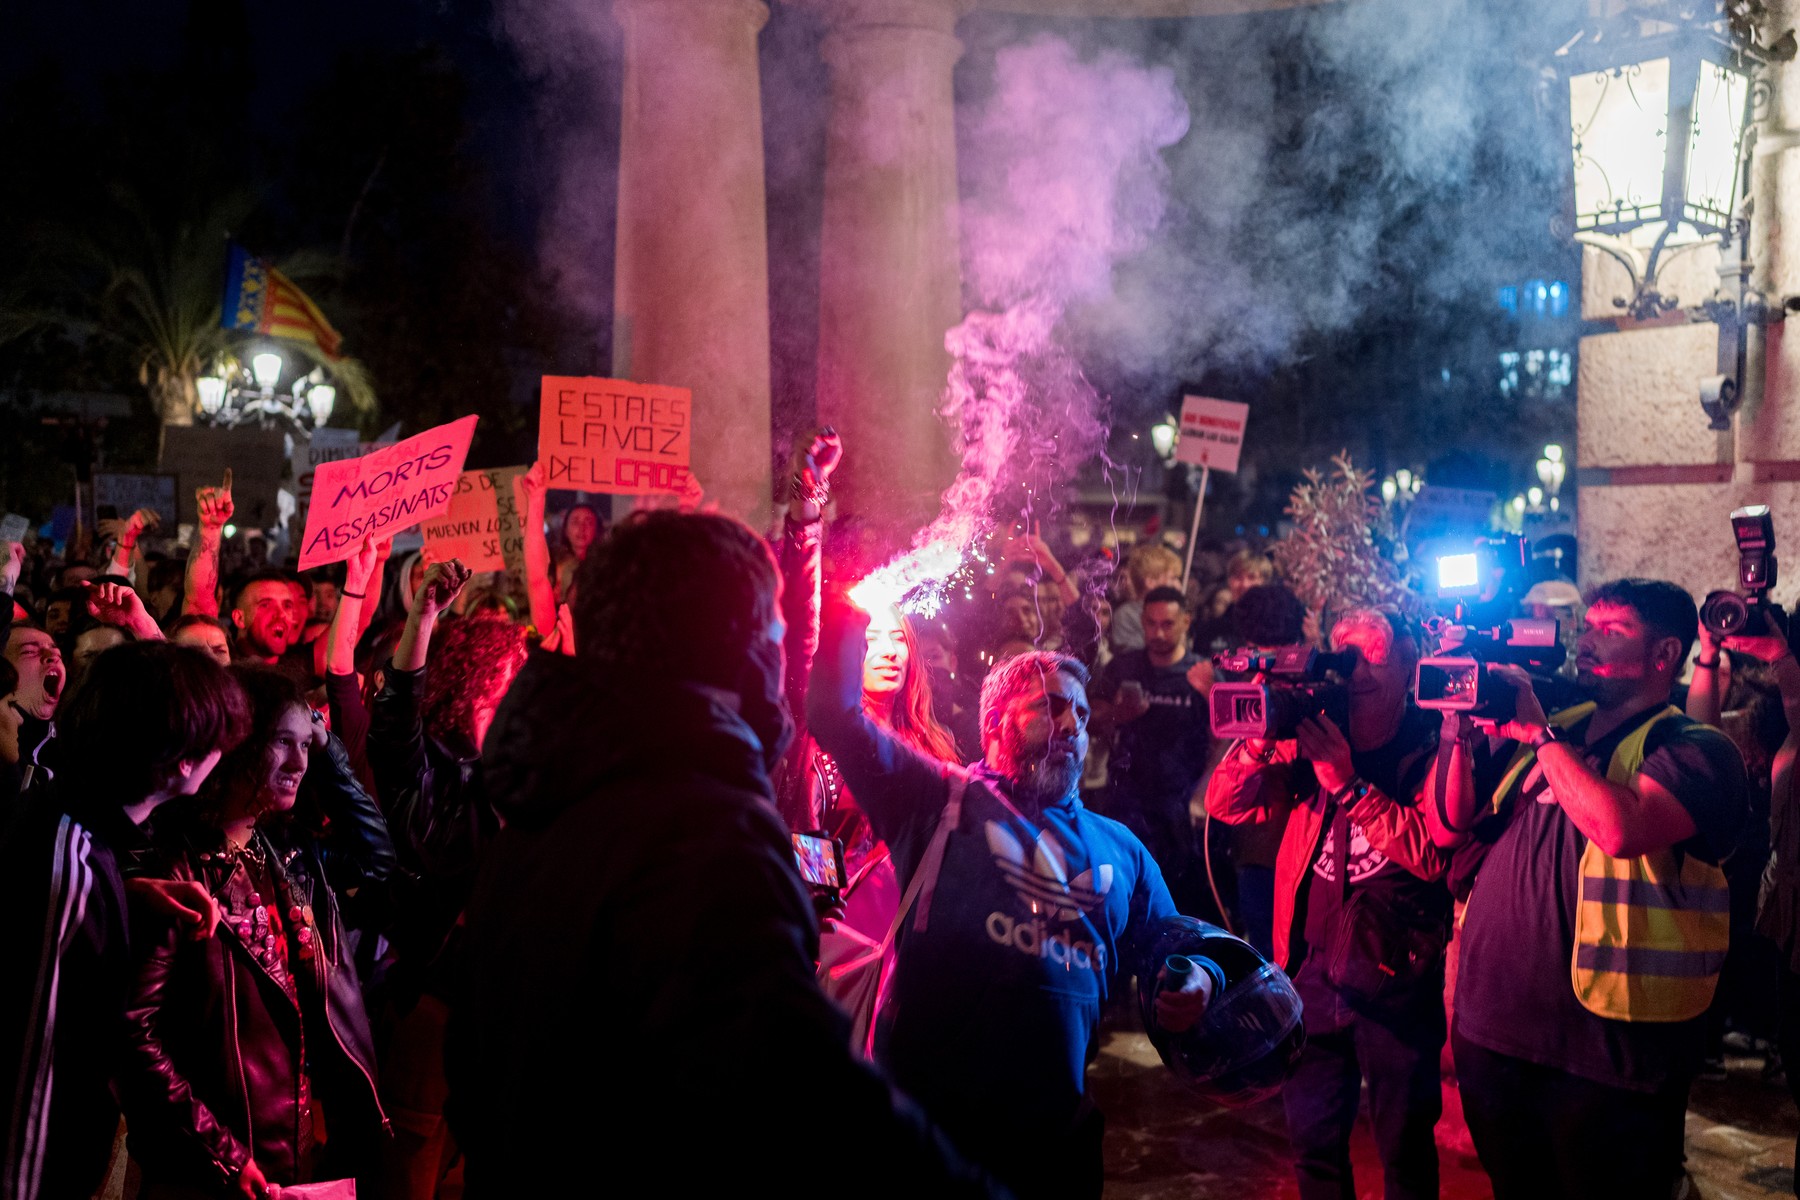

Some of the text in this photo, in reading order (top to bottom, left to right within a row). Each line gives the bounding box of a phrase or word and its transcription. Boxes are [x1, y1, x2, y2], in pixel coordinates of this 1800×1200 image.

[331, 445, 453, 509] MORTS
[478, 472, 504, 491] DE
[549, 454, 690, 491] DEL CAOS
[427, 520, 480, 541] MUEVEN
[486, 518, 512, 533] LOS
[483, 539, 500, 558] SE
[985, 911, 1105, 971] adidas
